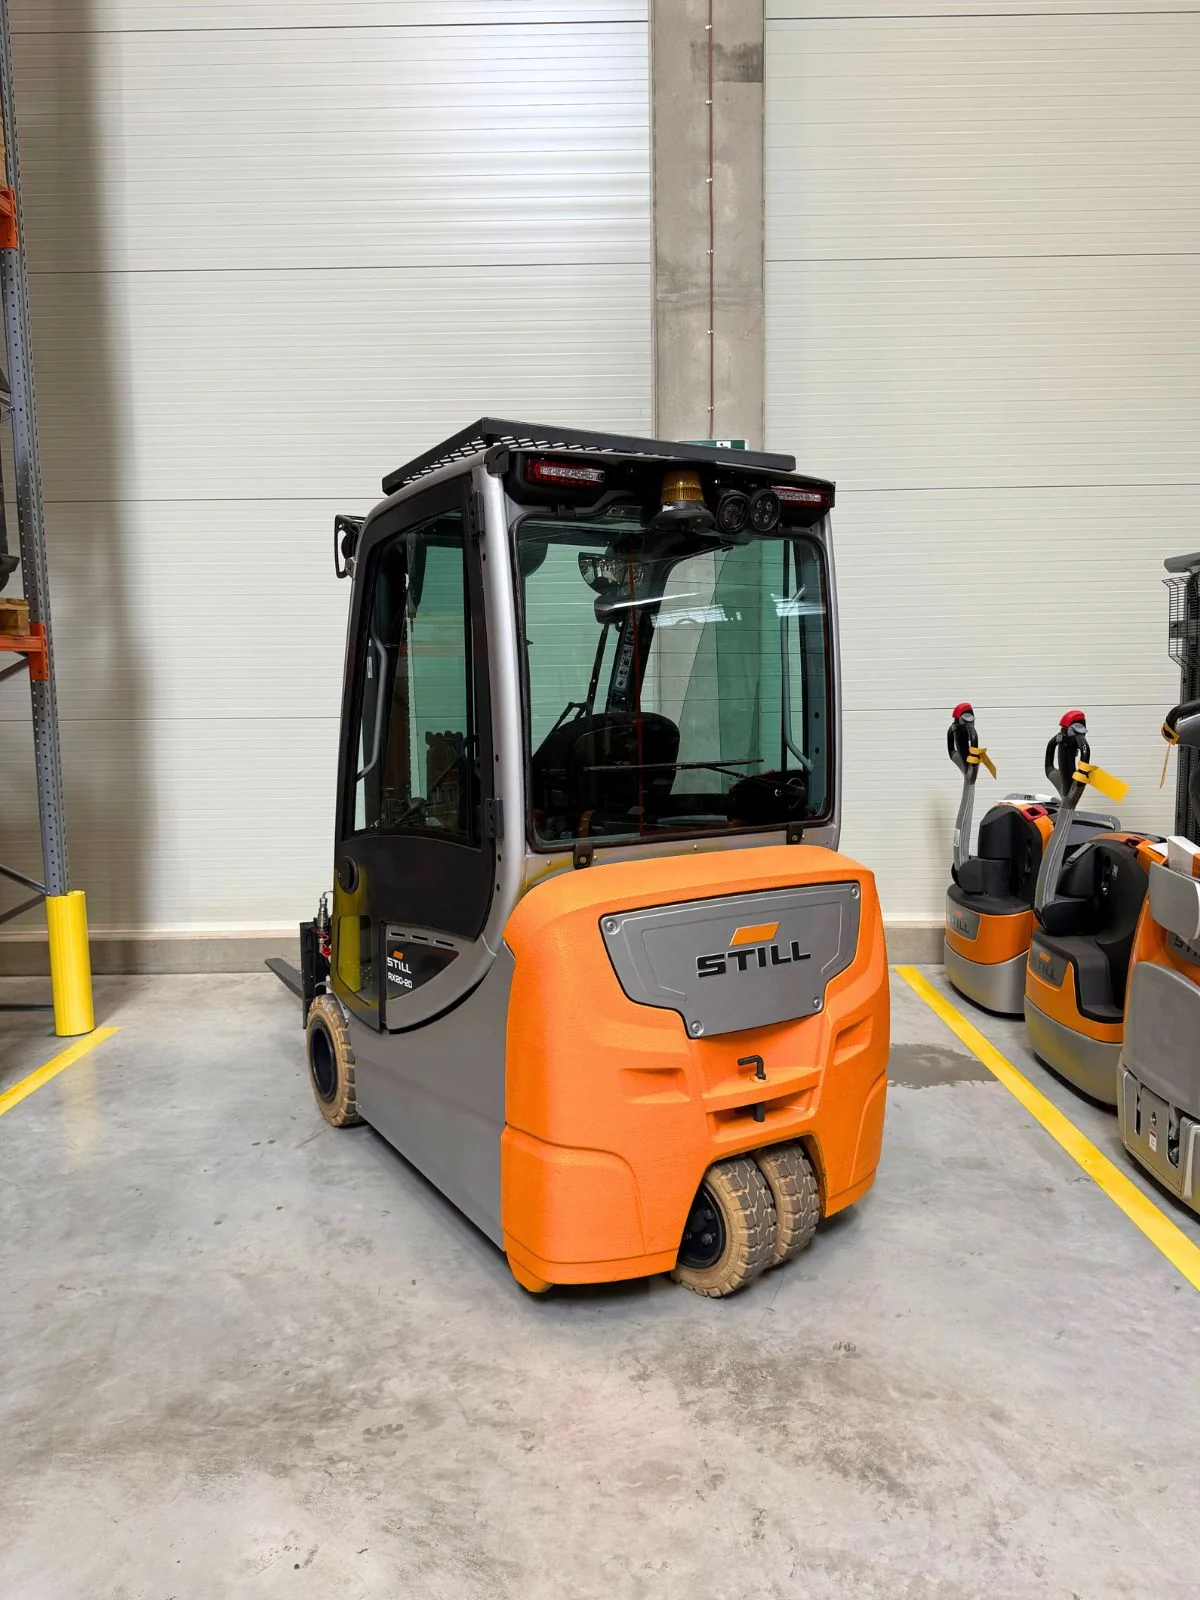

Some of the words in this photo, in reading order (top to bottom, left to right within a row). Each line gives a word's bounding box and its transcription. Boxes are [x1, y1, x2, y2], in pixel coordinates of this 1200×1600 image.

[386, 957, 412, 974] STILL
[696, 940, 811, 978] STILL
[388, 972, 413, 989] RX20-20
